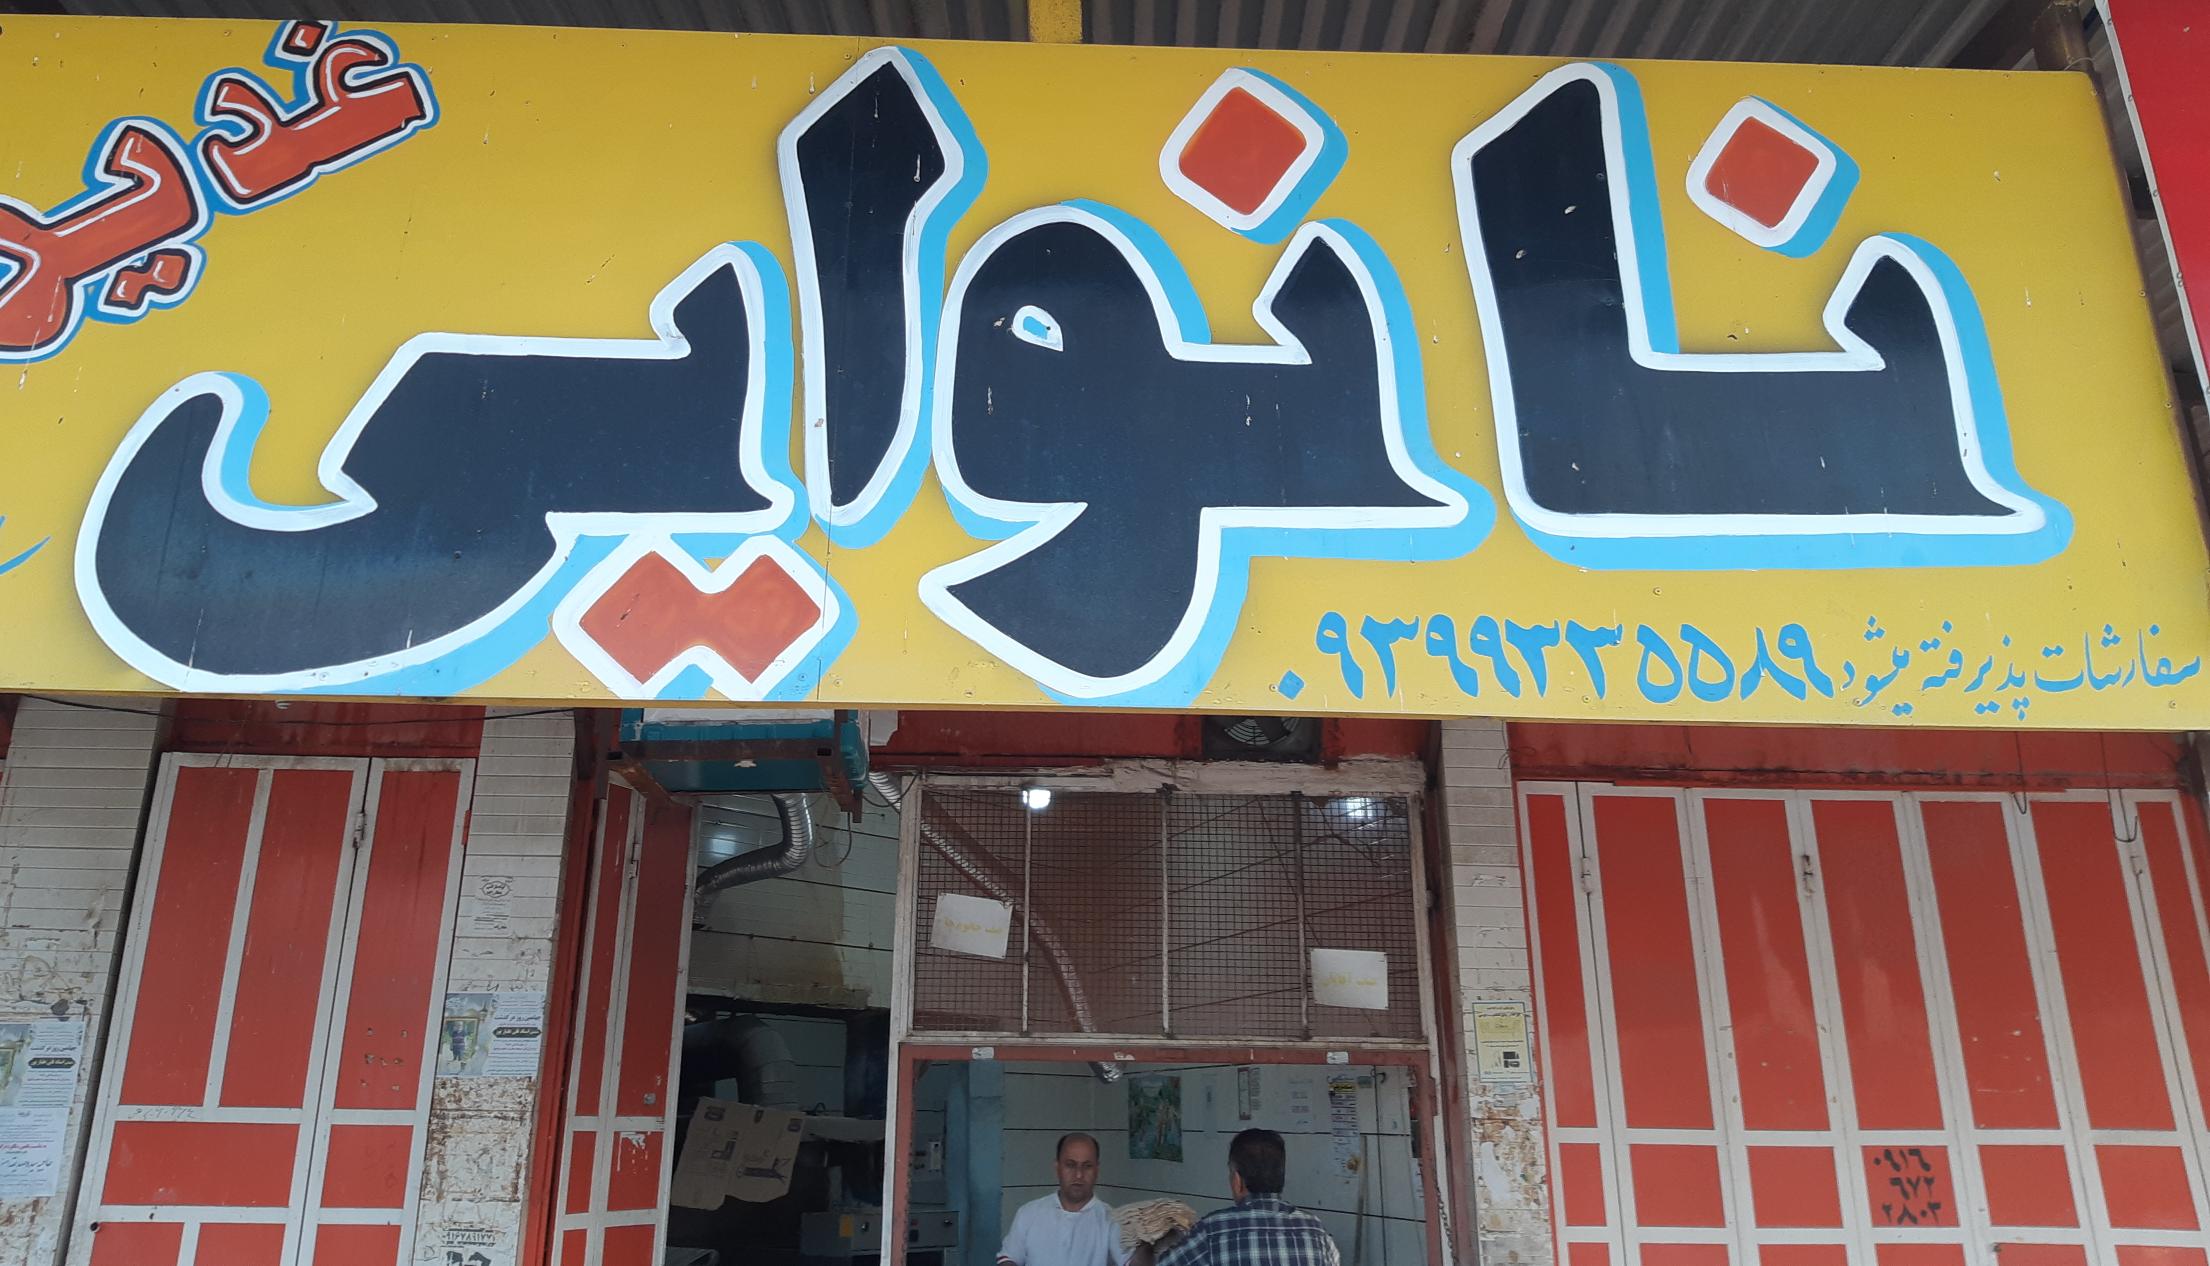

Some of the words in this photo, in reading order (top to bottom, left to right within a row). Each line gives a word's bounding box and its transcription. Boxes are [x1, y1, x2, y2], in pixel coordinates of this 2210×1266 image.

[74, 46, 2074, 702] نانوایی
[1919, 619, 2030, 720] پذیرفته
[2034, 624, 2202, 694] سفارشات
